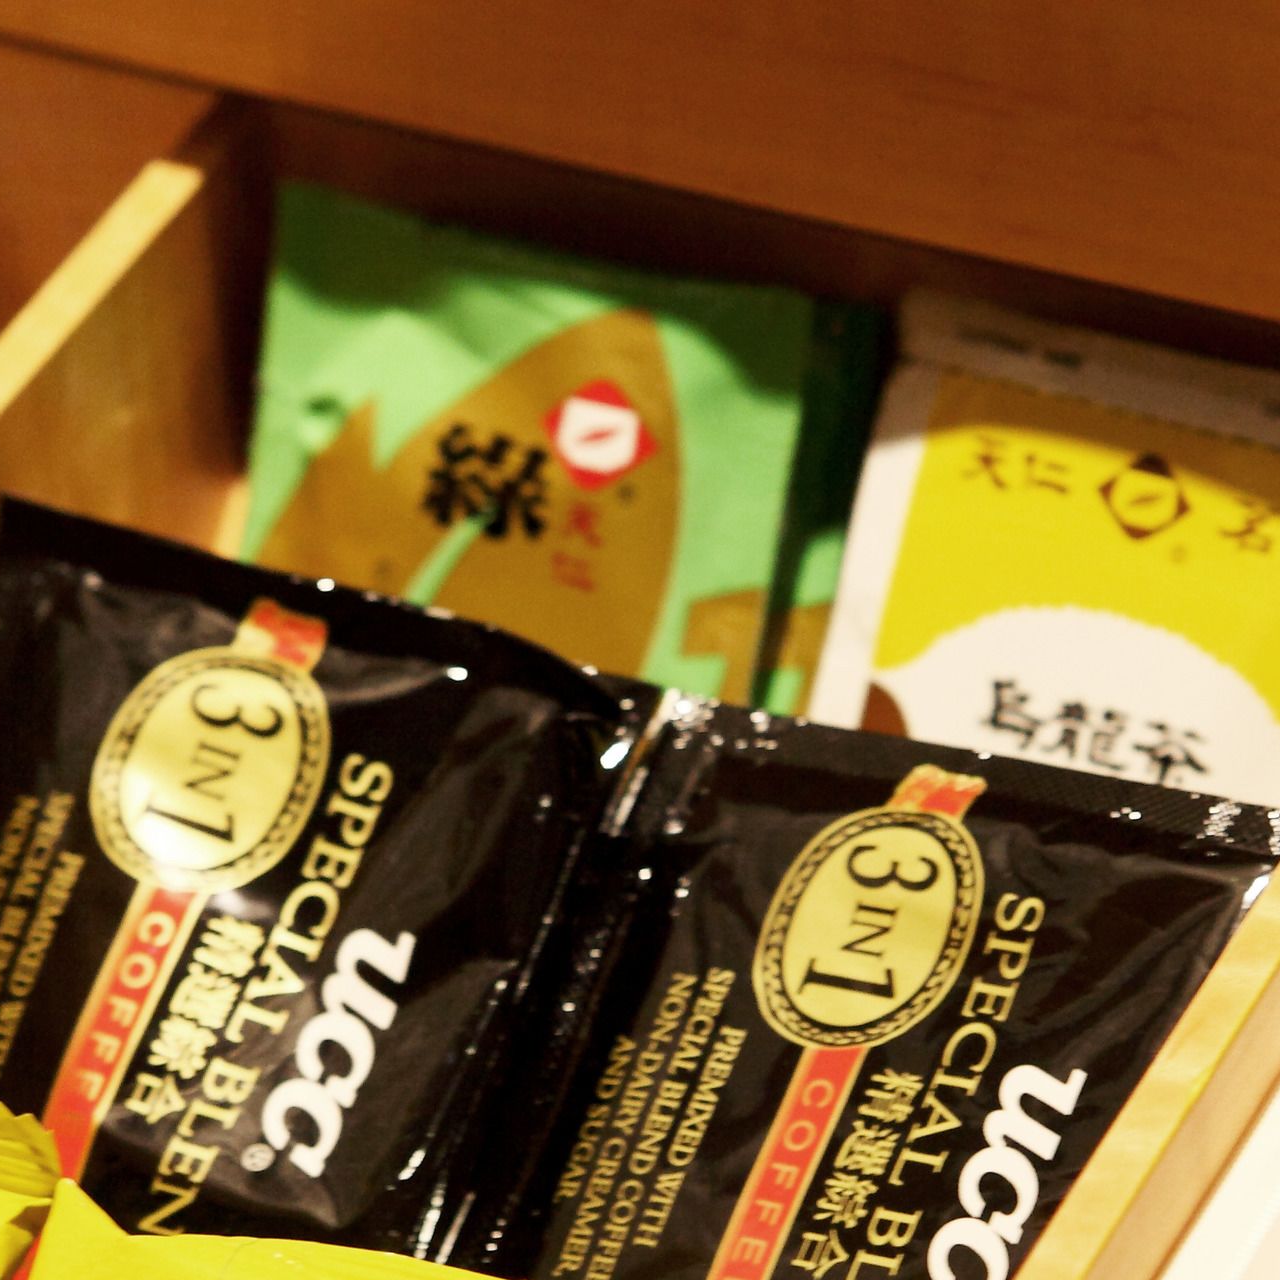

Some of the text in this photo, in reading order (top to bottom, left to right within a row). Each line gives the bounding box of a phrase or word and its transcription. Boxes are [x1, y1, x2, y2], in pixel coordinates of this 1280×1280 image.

[145, 684, 283, 844] 3 IN 1
[979, 680, 1209, 787] 烏龍茶
[223, 752, 394, 1043] SPECIAL
[796, 844, 939, 1002] 3 IN 1
[596, 1034, 637, 1101] AND
[612, 972, 698, 1136] NON-DAIRY
[669, 966, 737, 1075] SPECIAL
[887, 892, 1045, 1187] SPECIAL
[137, 1058, 262, 1236] BLEN
[628, 1079, 688, 1177] BLEND
[632, 1024, 749, 1249] PREMIXED WITH
[791, 1067, 923, 1280] 精選綜合
